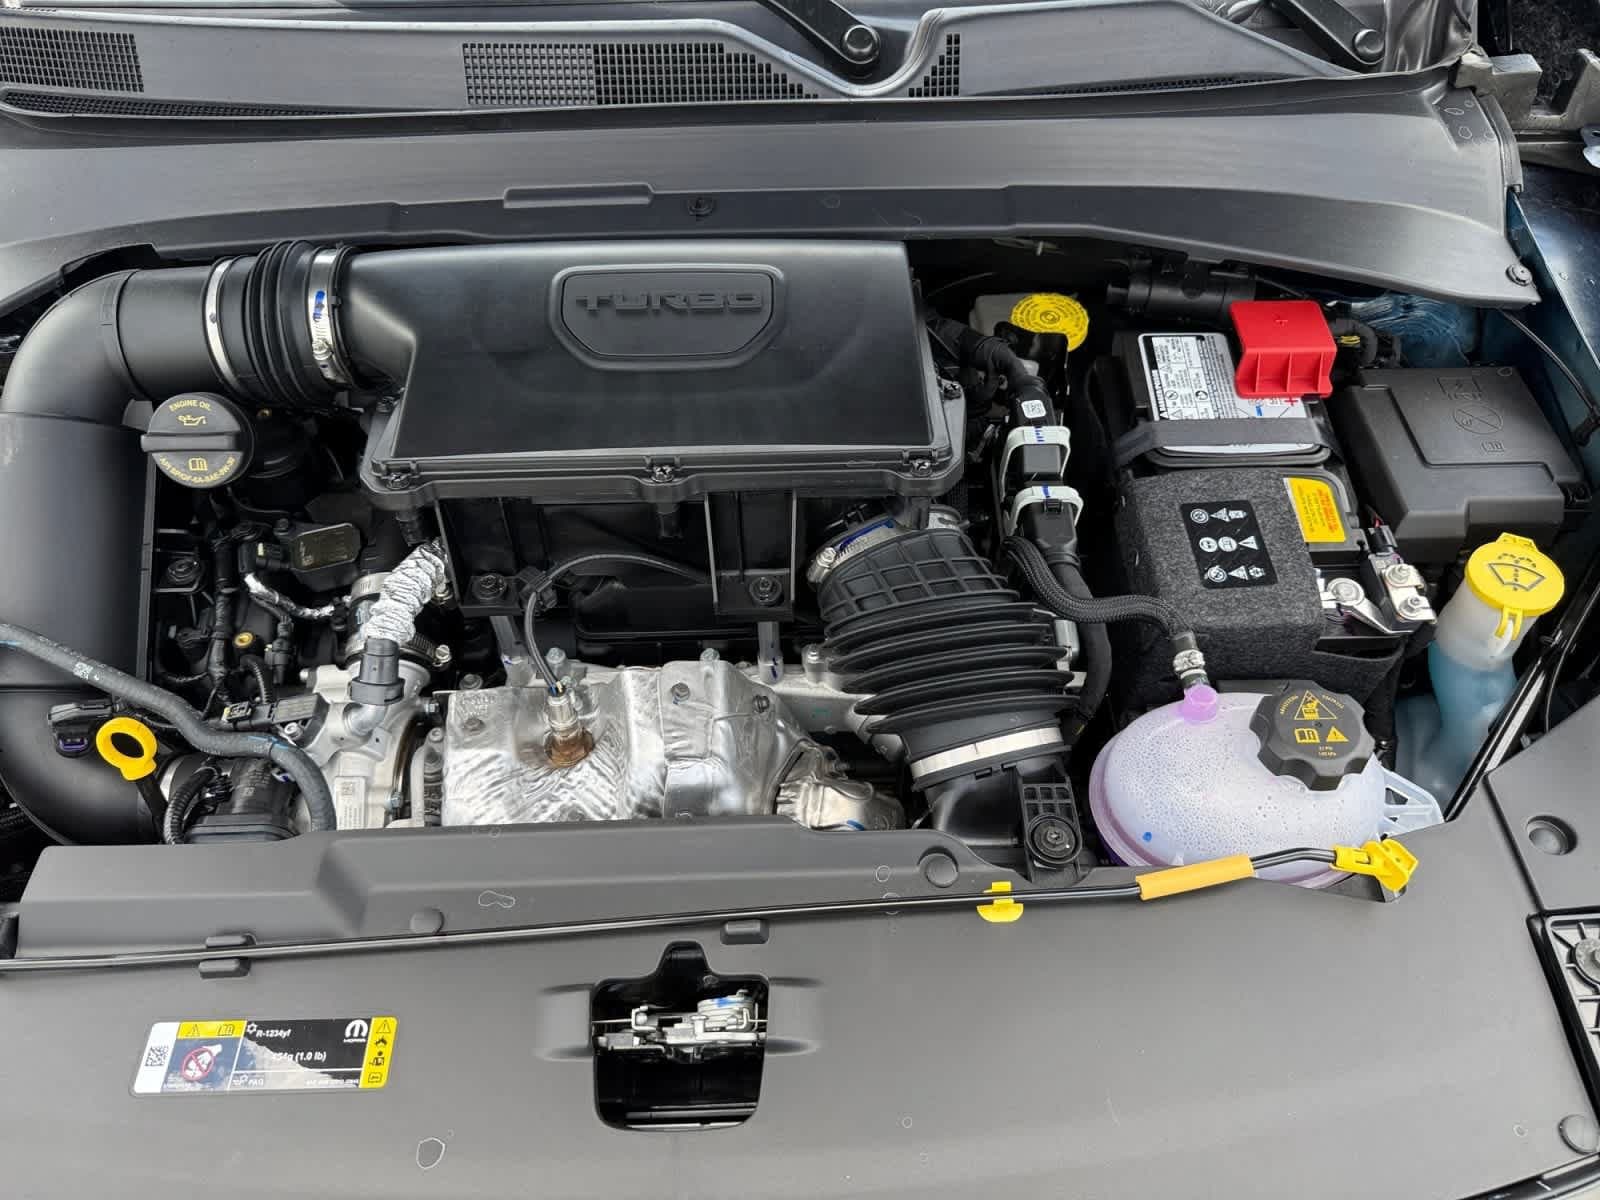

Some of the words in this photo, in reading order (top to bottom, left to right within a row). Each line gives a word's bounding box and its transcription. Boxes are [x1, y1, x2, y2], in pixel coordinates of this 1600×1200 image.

[576, 292, 763, 314] TURBO
[169, 399, 198, 411] ENGINE
[200, 400, 212, 411] OIL
[256, 1029, 291, 1038] R-1234yf
[295, 1052, 312, 1062] (1.0
[314, 1052, 327, 1062] lb)
